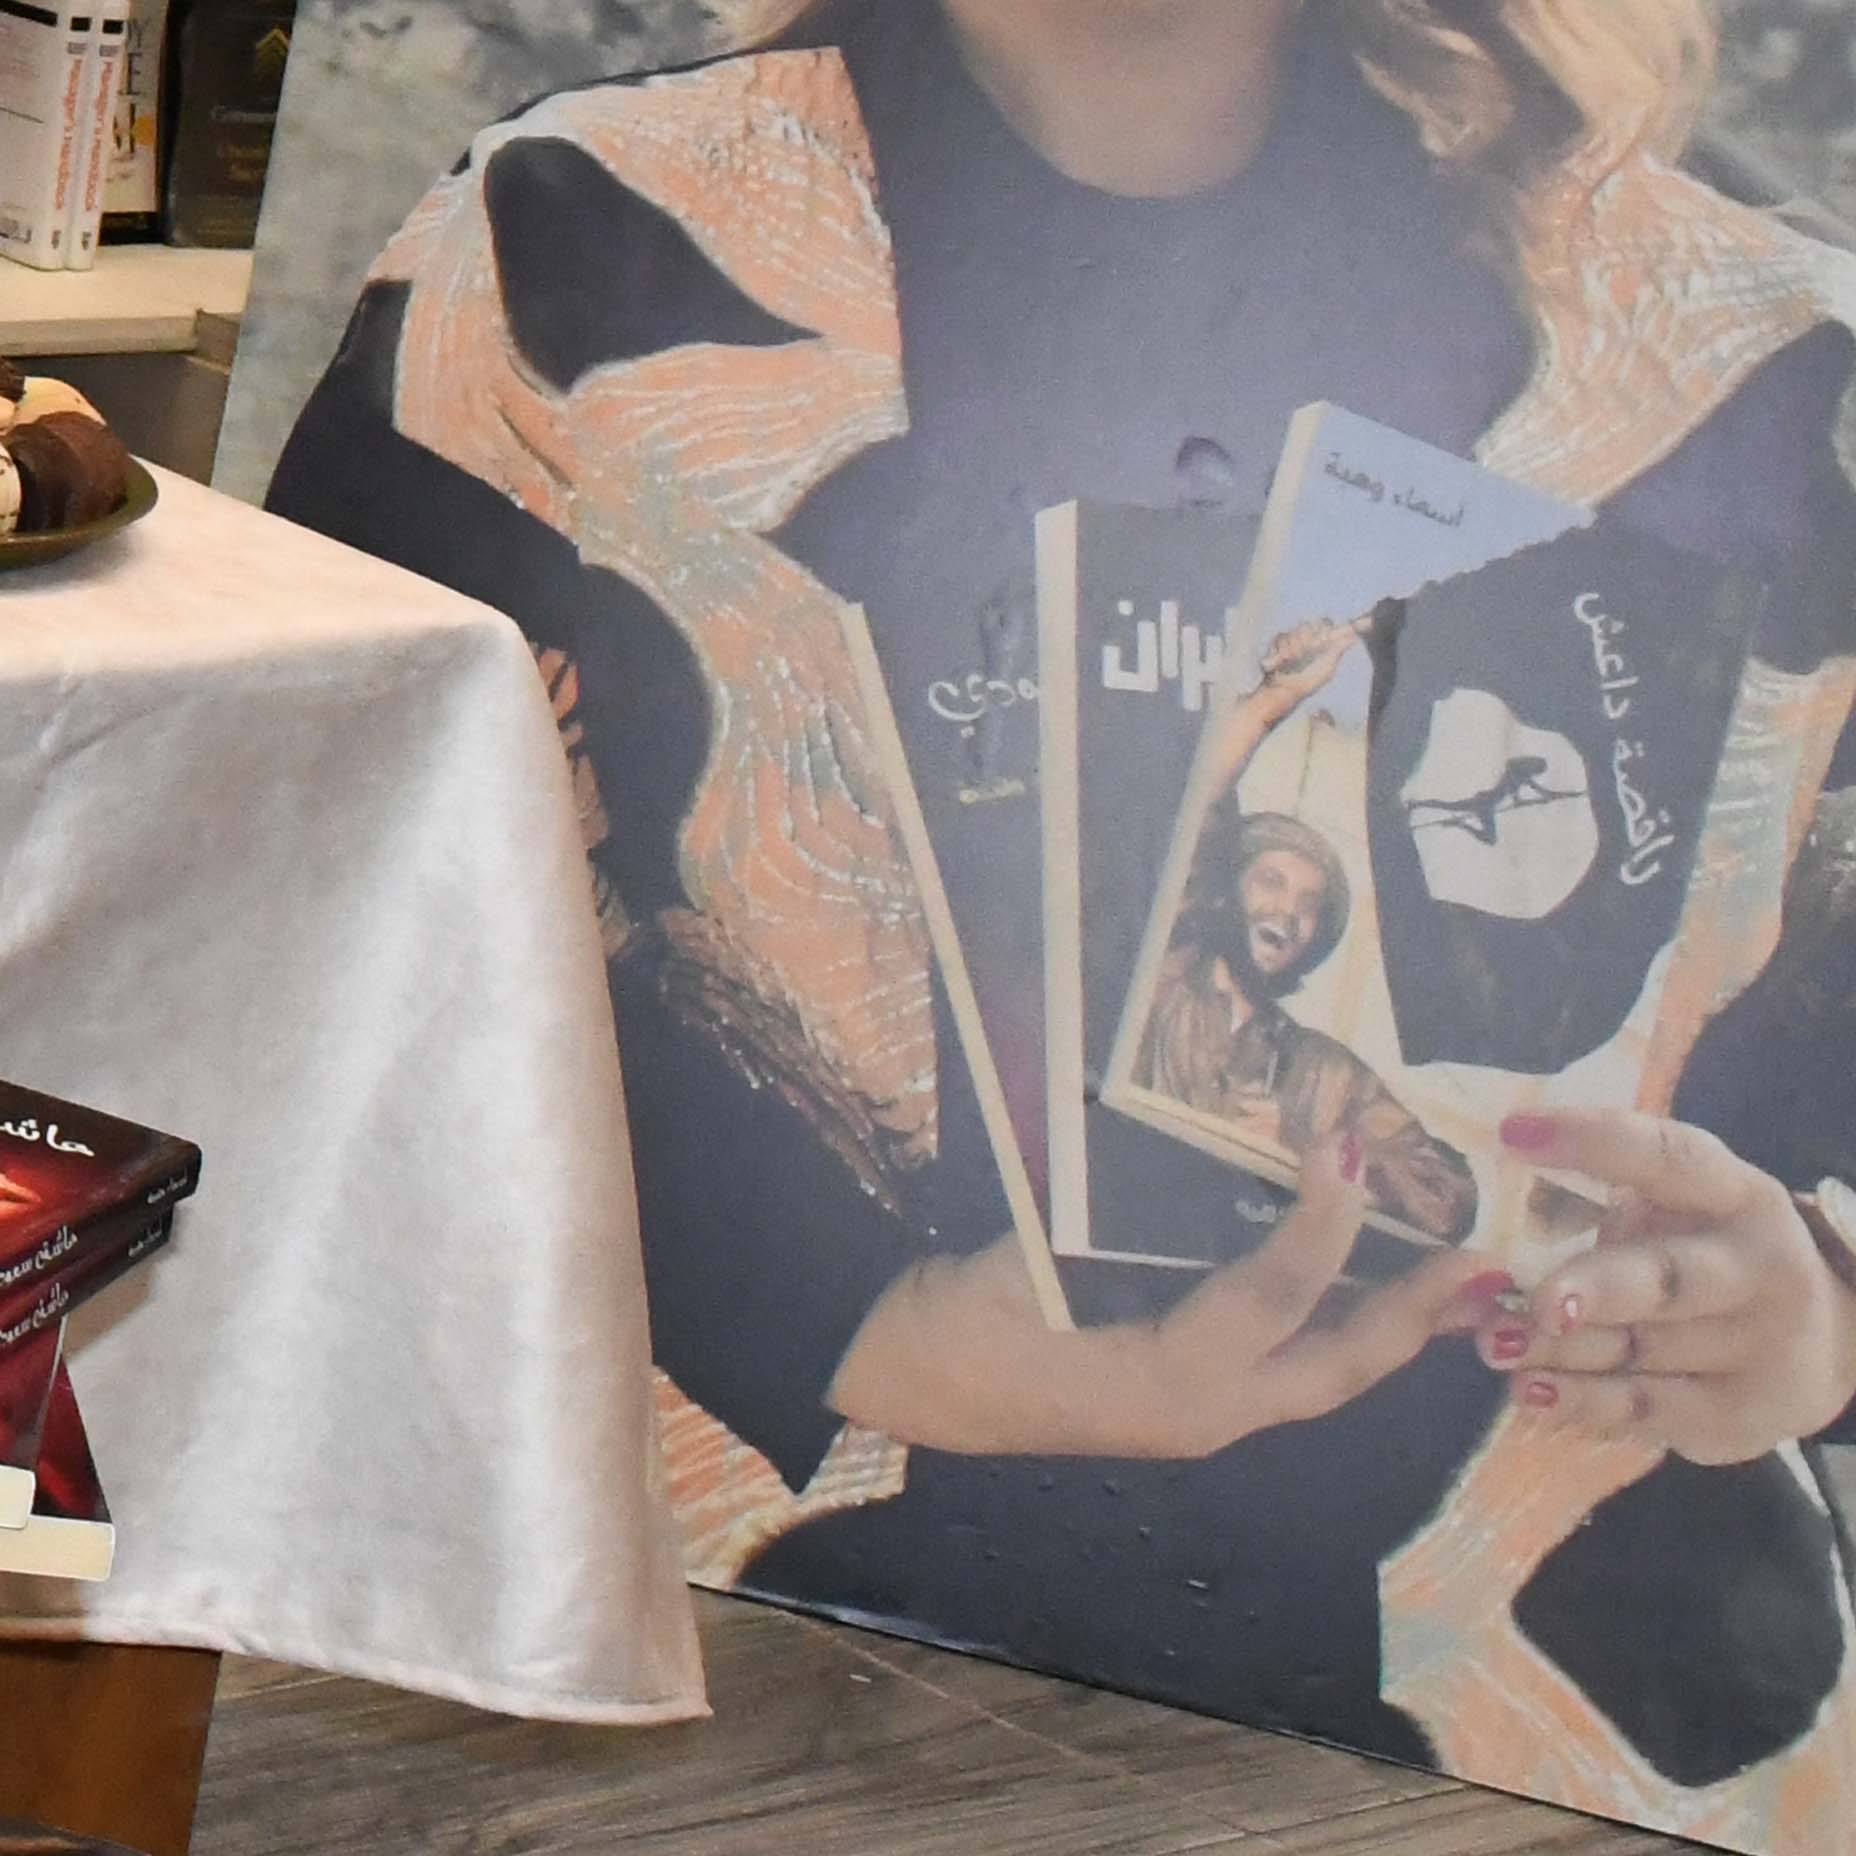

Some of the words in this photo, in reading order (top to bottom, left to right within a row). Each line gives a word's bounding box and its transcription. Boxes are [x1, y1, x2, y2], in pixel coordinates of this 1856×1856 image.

[1323, 448, 1386, 506] وهبة
[1392, 488, 1466, 530] أسماء
[1573, 591, 1640, 720] داعش
[1611, 741, 1676, 888] راقصة
[34, 1225, 79, 1270] عاشق
[32, 1281, 69, 1328] عاشق
